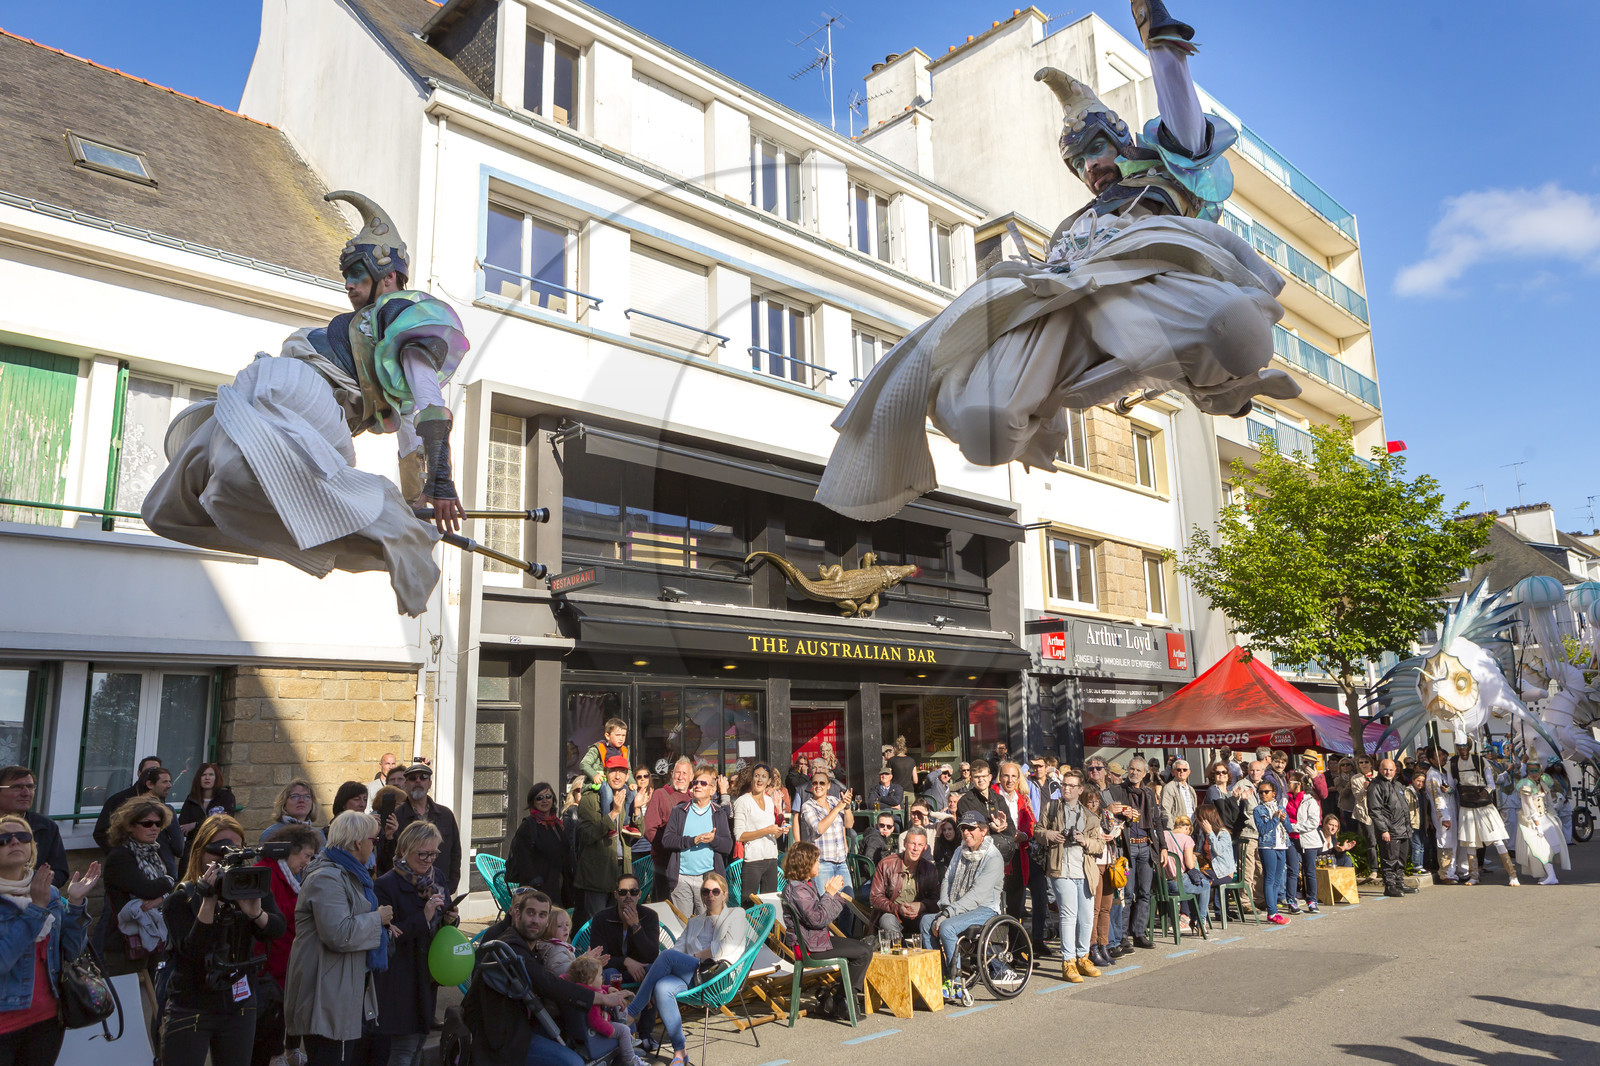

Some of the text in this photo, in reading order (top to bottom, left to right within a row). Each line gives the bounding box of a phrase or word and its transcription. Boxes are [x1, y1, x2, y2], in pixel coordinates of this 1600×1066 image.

[551, 570, 594, 591] RESTAURANT
[1047, 635, 1065, 647] Arthur
[1086, 624, 1151, 656] Arthur Loyd
[748, 635, 937, 664] THE AUSTRALIAN BAR
[1052, 648, 1066, 660] Loyd
[1172, 649, 1186, 659] Arthur
[1096, 656, 1103, 664] EN
[1104, 656, 1131, 667] IMMOBILIER
[1131, 658, 1162, 670] D'ENTREPRISE
[1176, 658, 1187, 670] Loyd
[1137, 732, 1250, 745] STELLA ARTOIS
